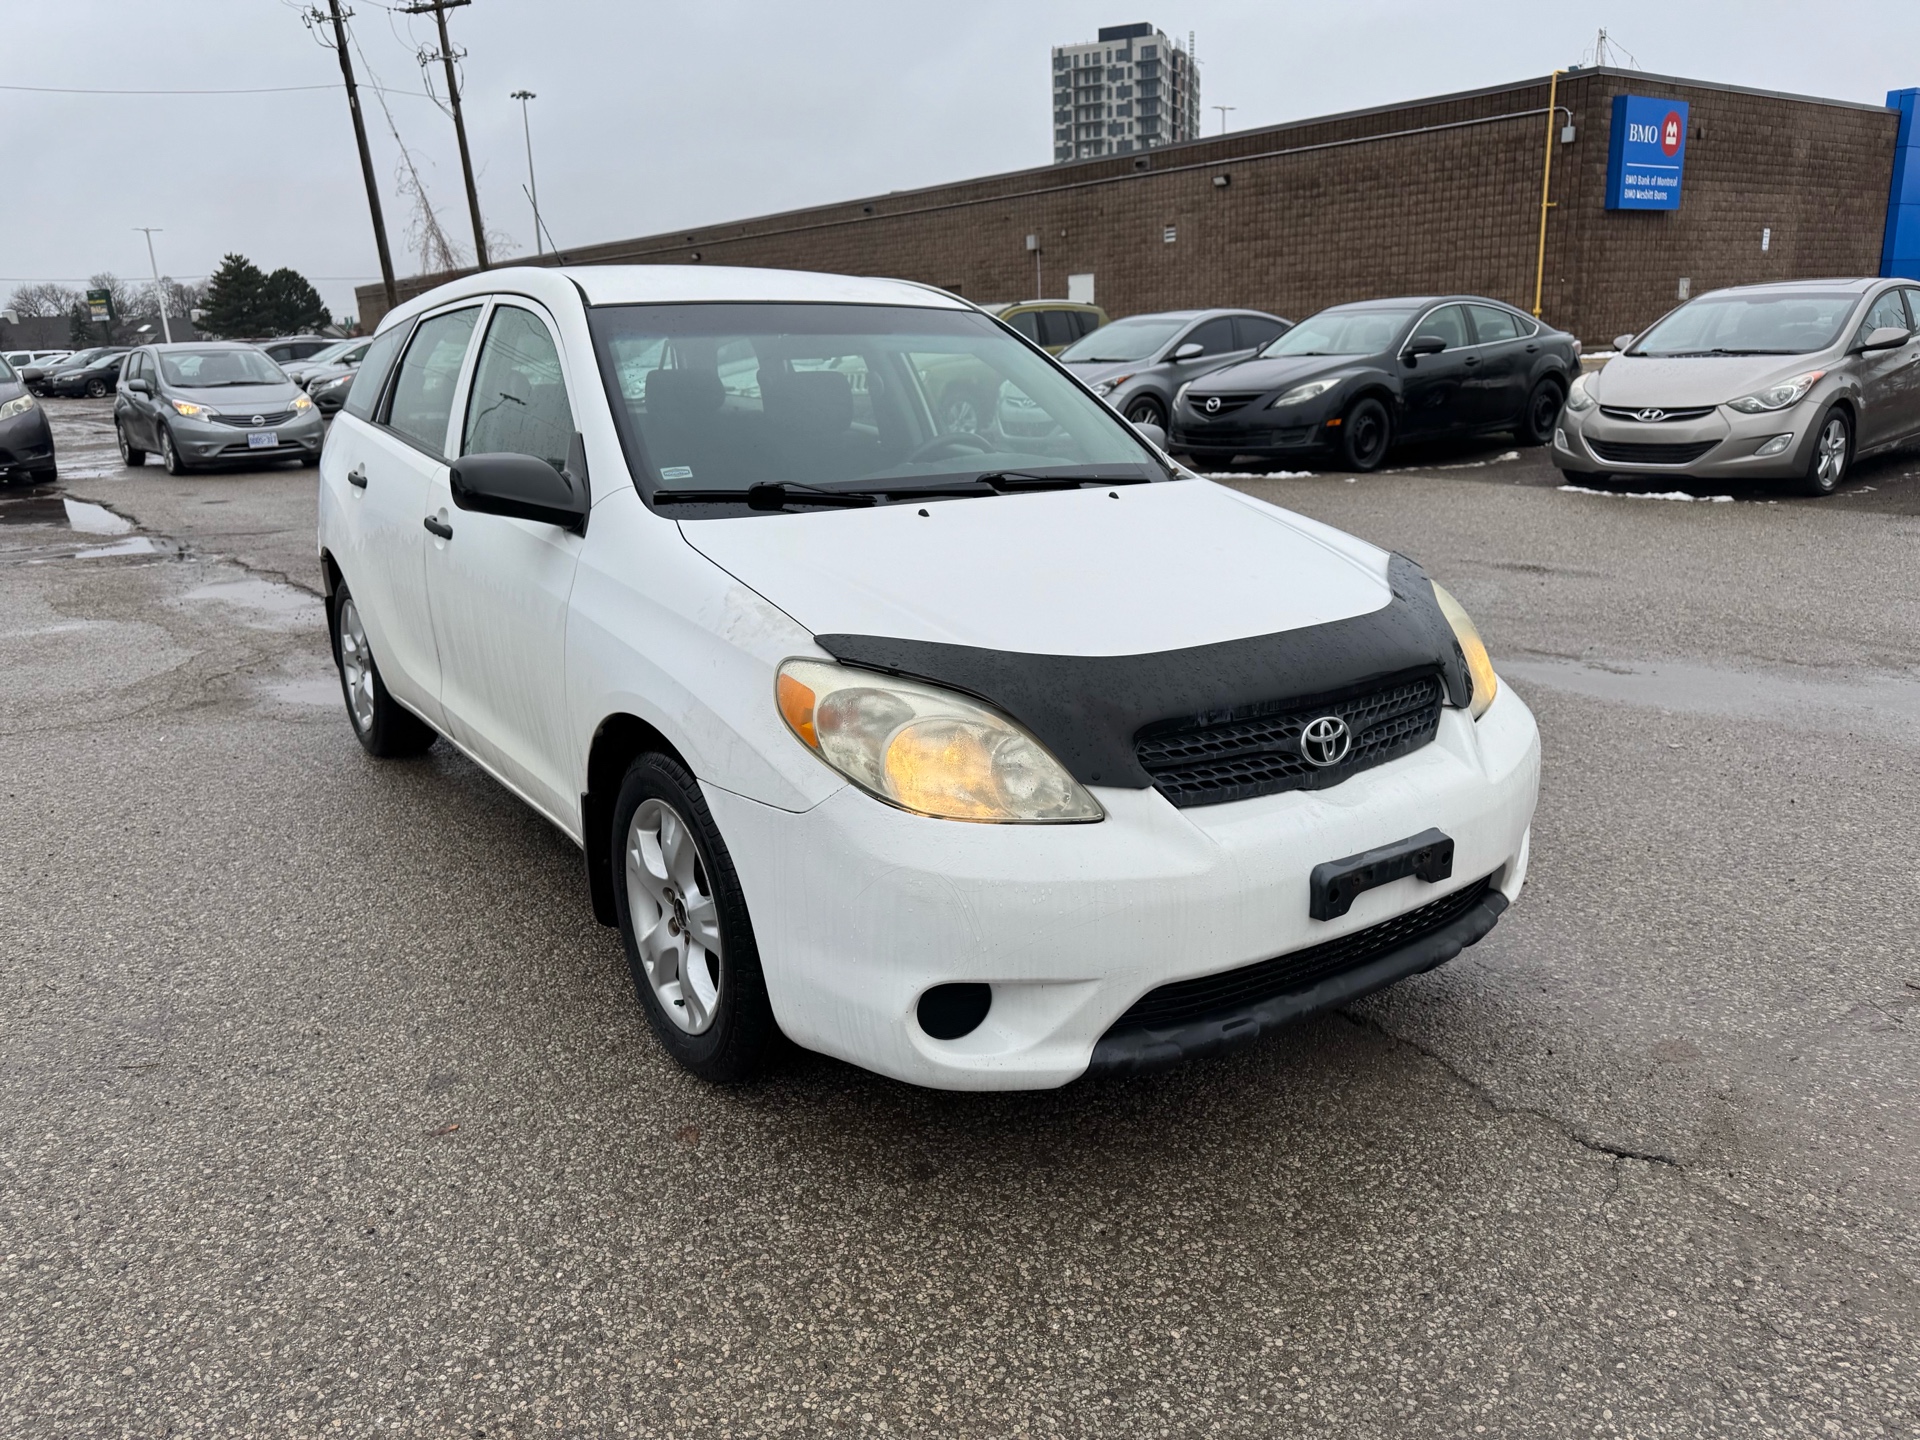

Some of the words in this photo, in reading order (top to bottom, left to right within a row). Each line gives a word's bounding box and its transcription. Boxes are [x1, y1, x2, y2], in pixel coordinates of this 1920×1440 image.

[1629, 123, 1658, 144] BMO
[1625, 174, 1637, 185] BMO
[1637, 175, 1650, 186] Bank
[1650, 175, 1656, 186] of
[1656, 176, 1678, 187] Montreal
[1624, 188, 1636, 199] BMO
[1654, 190, 1667, 200] Burns
